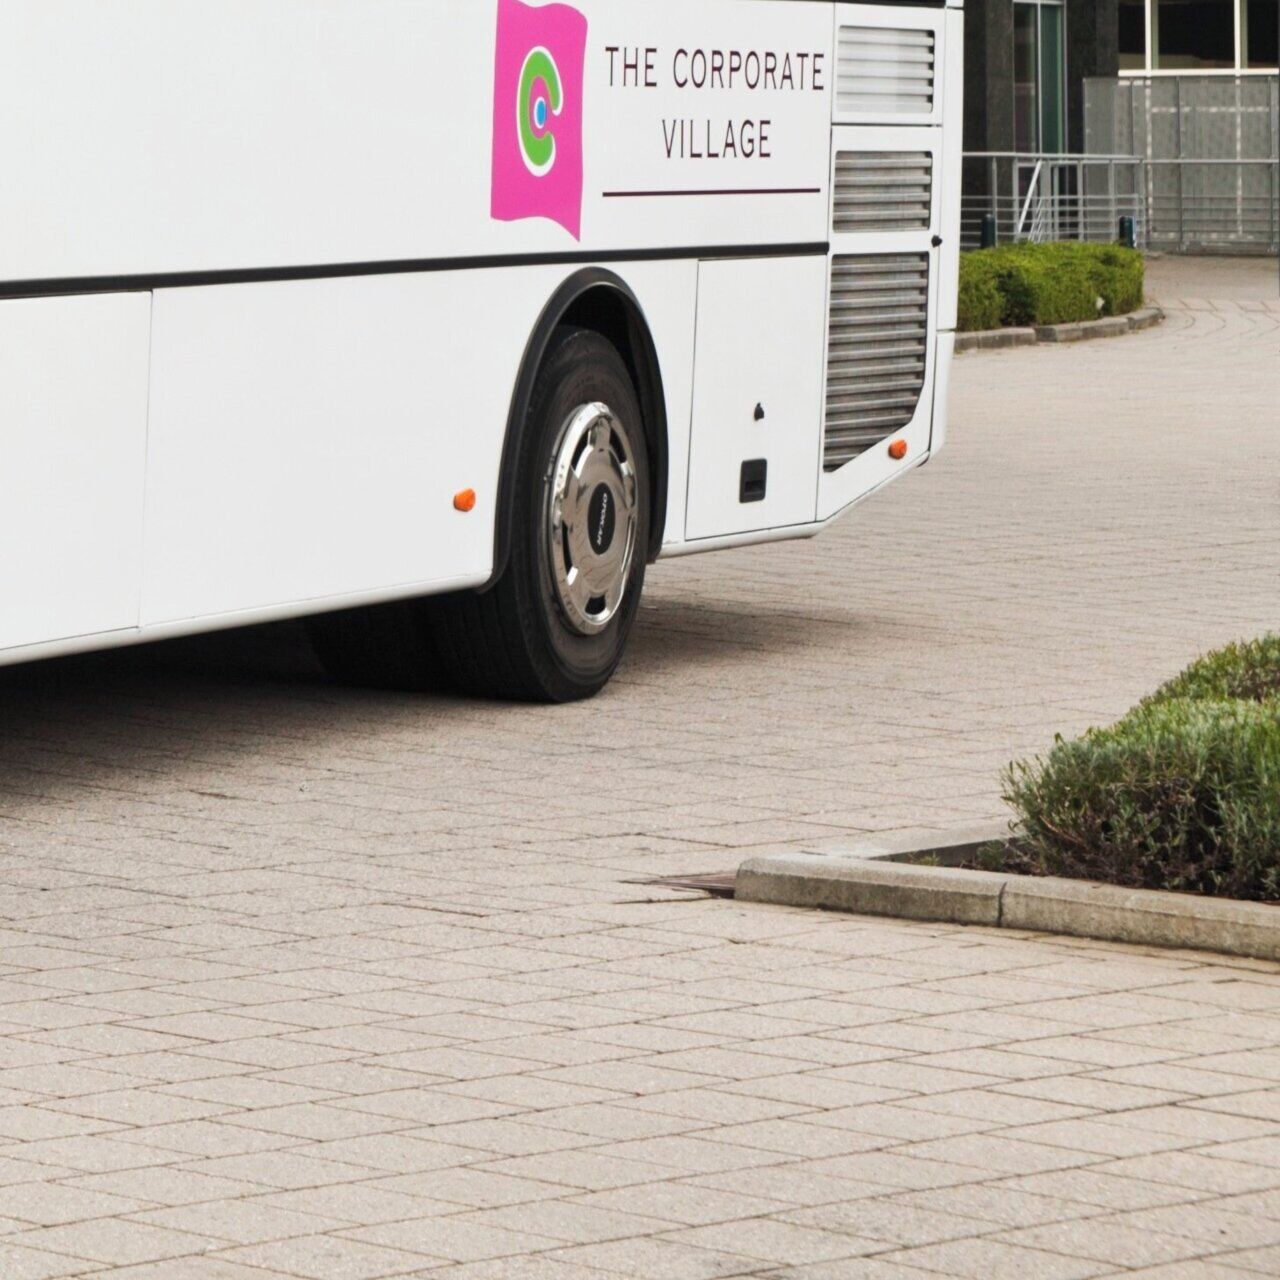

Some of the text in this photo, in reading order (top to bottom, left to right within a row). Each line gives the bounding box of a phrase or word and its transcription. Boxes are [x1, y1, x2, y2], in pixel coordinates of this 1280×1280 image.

[605, 47, 824, 90] THE CORPORATE
[662, 119, 771, 158] VILLAGE
